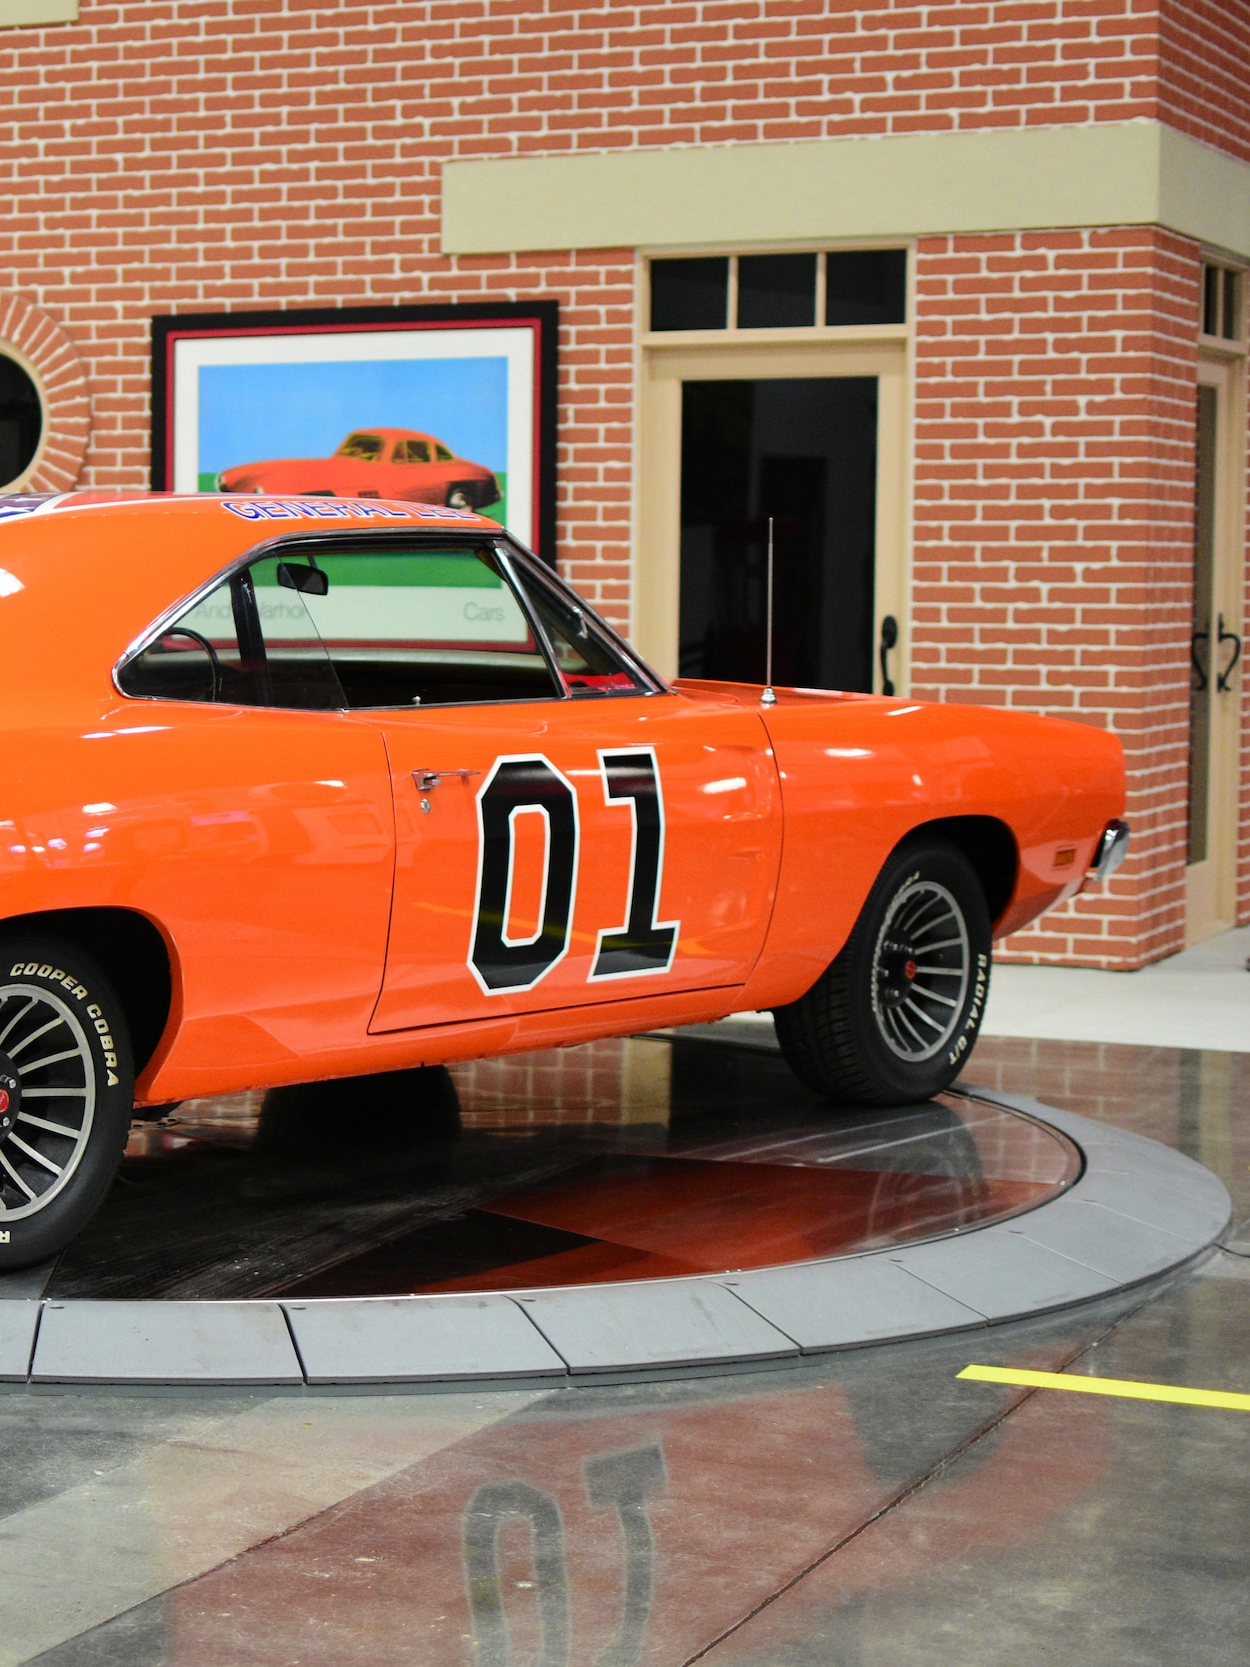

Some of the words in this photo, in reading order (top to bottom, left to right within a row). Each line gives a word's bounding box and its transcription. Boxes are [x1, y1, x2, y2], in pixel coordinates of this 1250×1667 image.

[220, 500, 412, 522] GENERAL
[195, 602, 231, 620] And
[463, 602, 505, 621] Cars
[467, 746, 681, 997] 01
[965, 953, 988, 1030] RADIAL
[9, 962, 89, 1000] COOPER
[86, 1003, 119, 1087] COBRA
